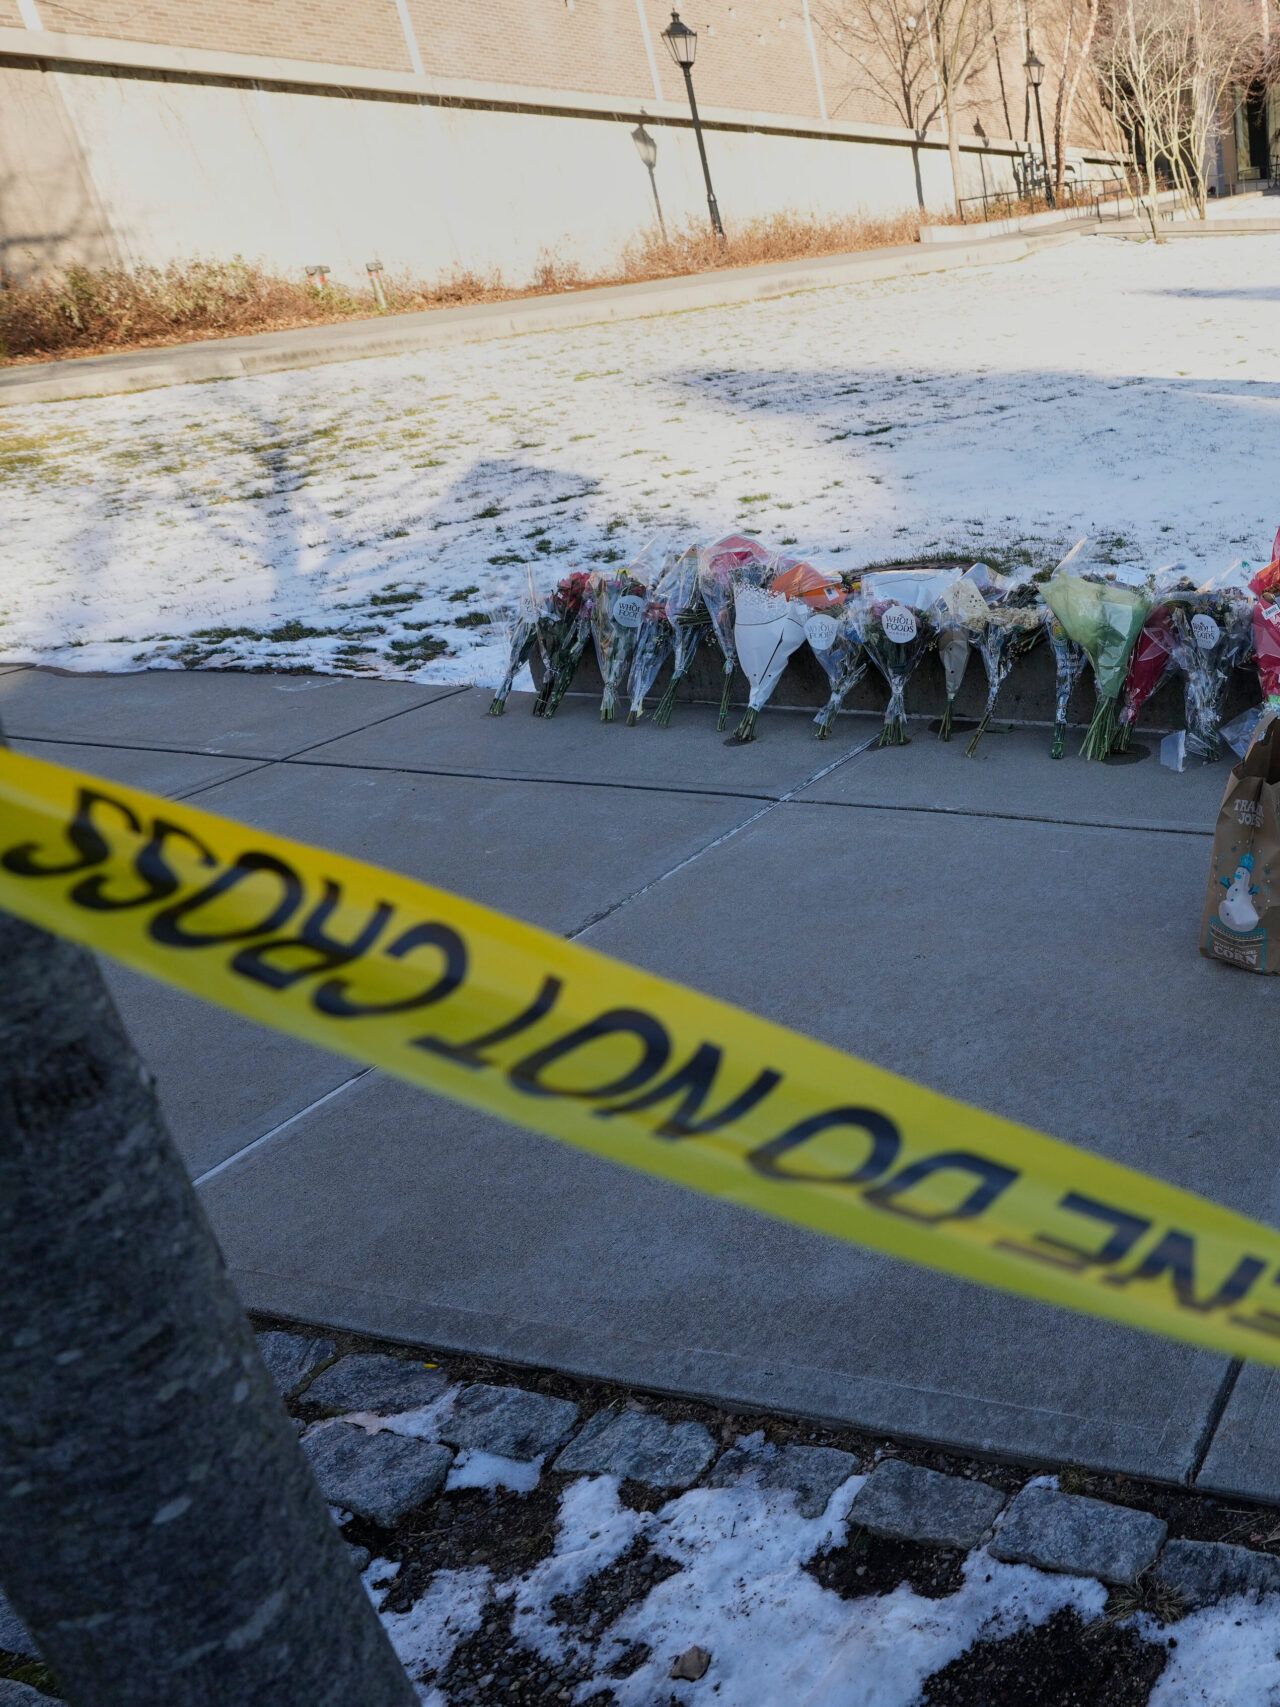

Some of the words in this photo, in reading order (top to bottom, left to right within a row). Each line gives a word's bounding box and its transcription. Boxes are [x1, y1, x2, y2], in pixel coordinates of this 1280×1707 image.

[886, 622, 914, 633] FOODS
[1, 787, 468, 1019] CROSS
[405, 974, 783, 1140] NOT
[746, 1106, 1020, 1224] DO
